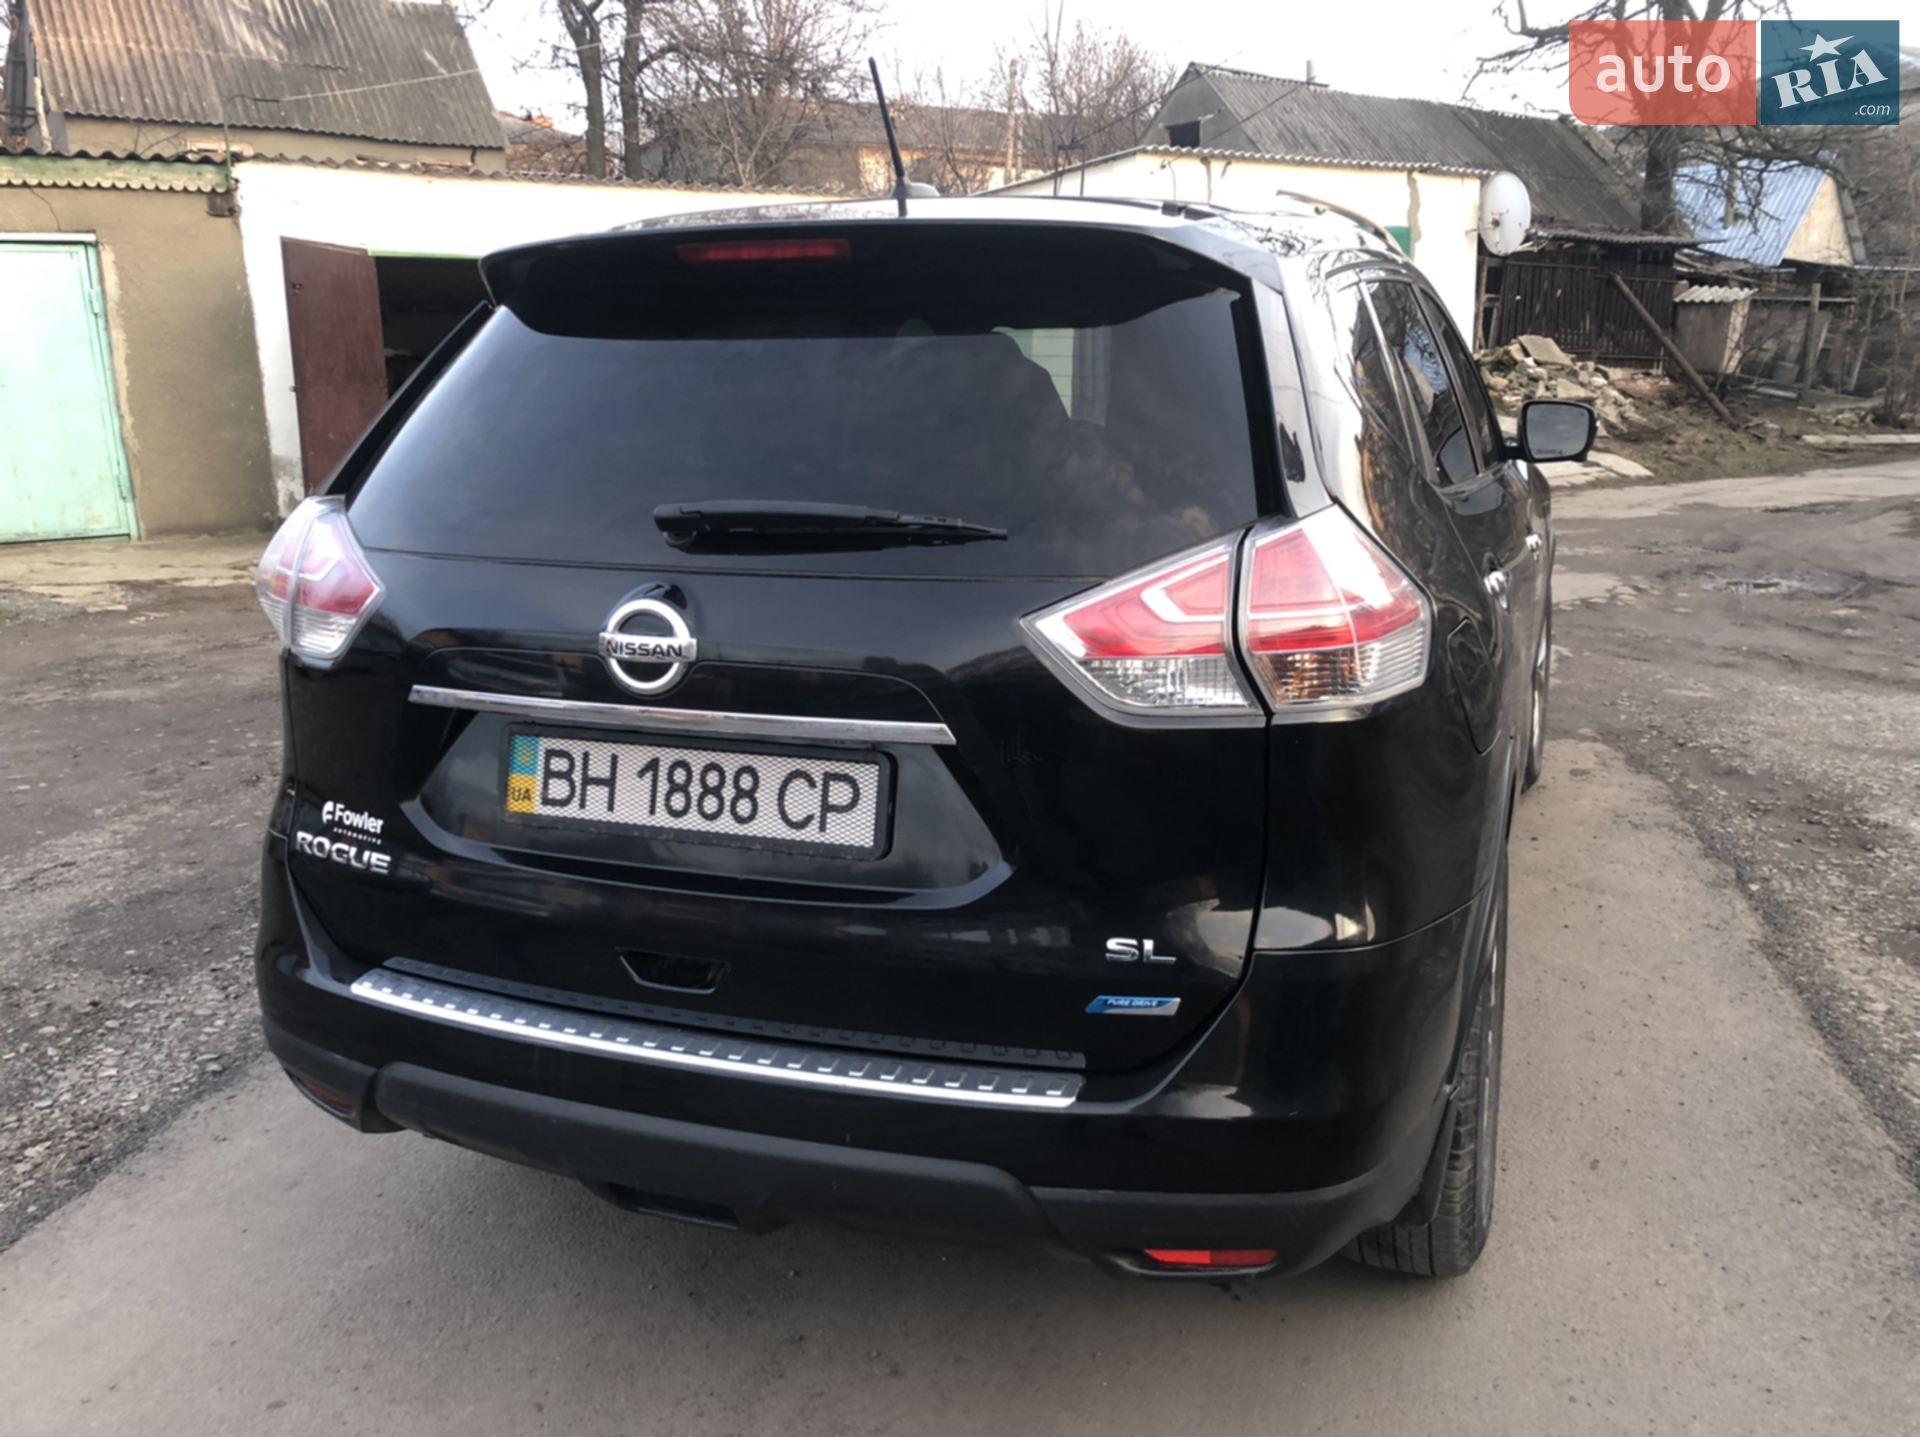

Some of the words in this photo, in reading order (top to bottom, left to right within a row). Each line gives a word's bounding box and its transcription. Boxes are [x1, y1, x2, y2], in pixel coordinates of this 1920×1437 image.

[606, 639, 683, 658] NISSAN
[511, 787, 532, 803] UA
[540, 748, 619, 813] BH
[636, 756, 761, 825] 1888
[777, 768, 861, 833] CP
[334, 802, 384, 834] Fowler
[296, 830, 392, 875] ROGUE
[1105, 937, 1177, 964] SL
